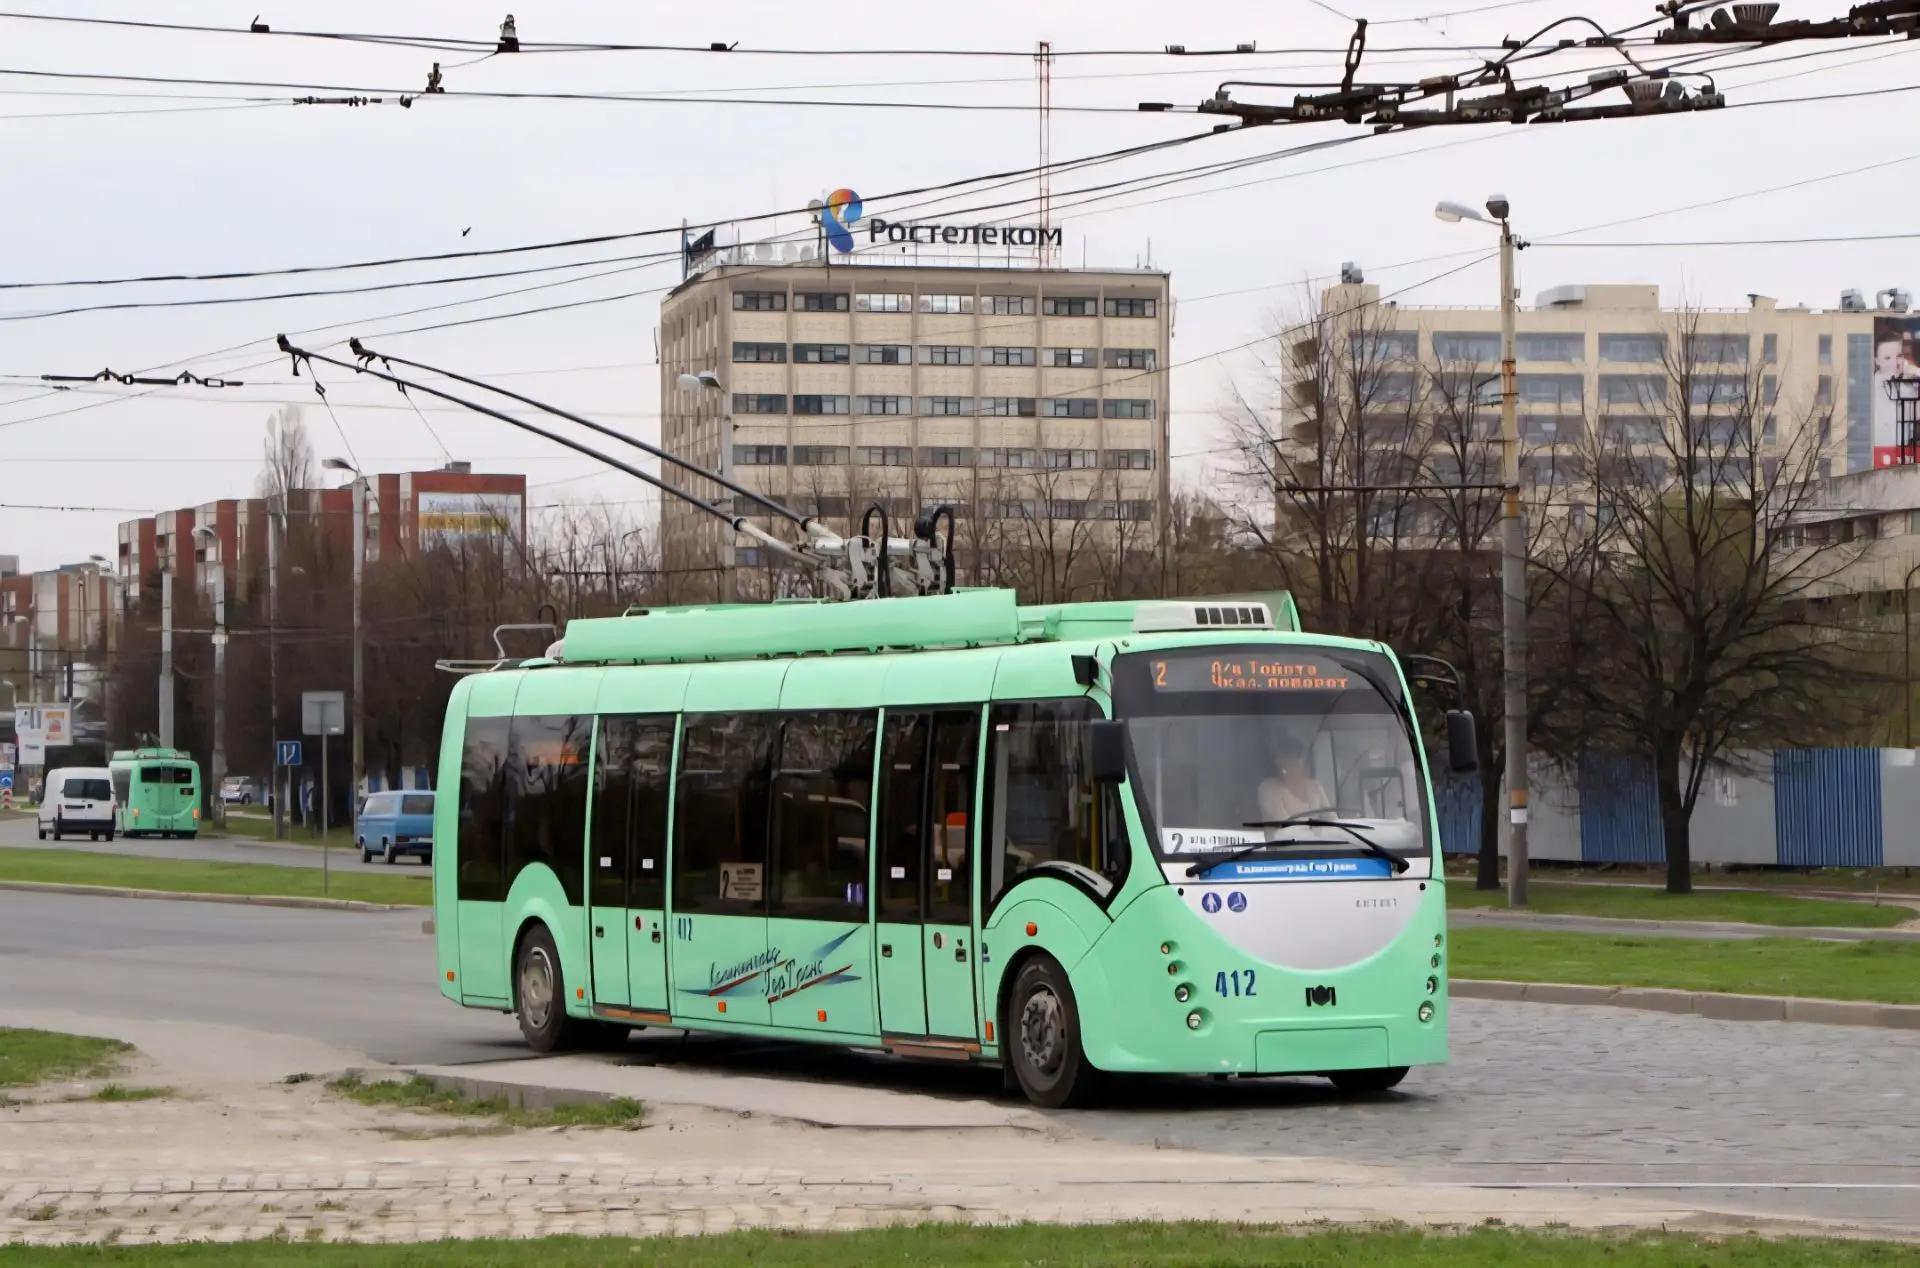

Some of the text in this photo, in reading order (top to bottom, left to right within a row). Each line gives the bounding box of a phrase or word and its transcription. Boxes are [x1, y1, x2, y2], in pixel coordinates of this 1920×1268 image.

[870, 218, 1062, 246] Ростелеком
[1156, 661, 1168, 687] 2
[1248, 661, 1318, 676] Тойота
[1171, 832, 1184, 855] 2
[678, 917, 692, 941] 412
[1215, 969, 1257, 998] 412
